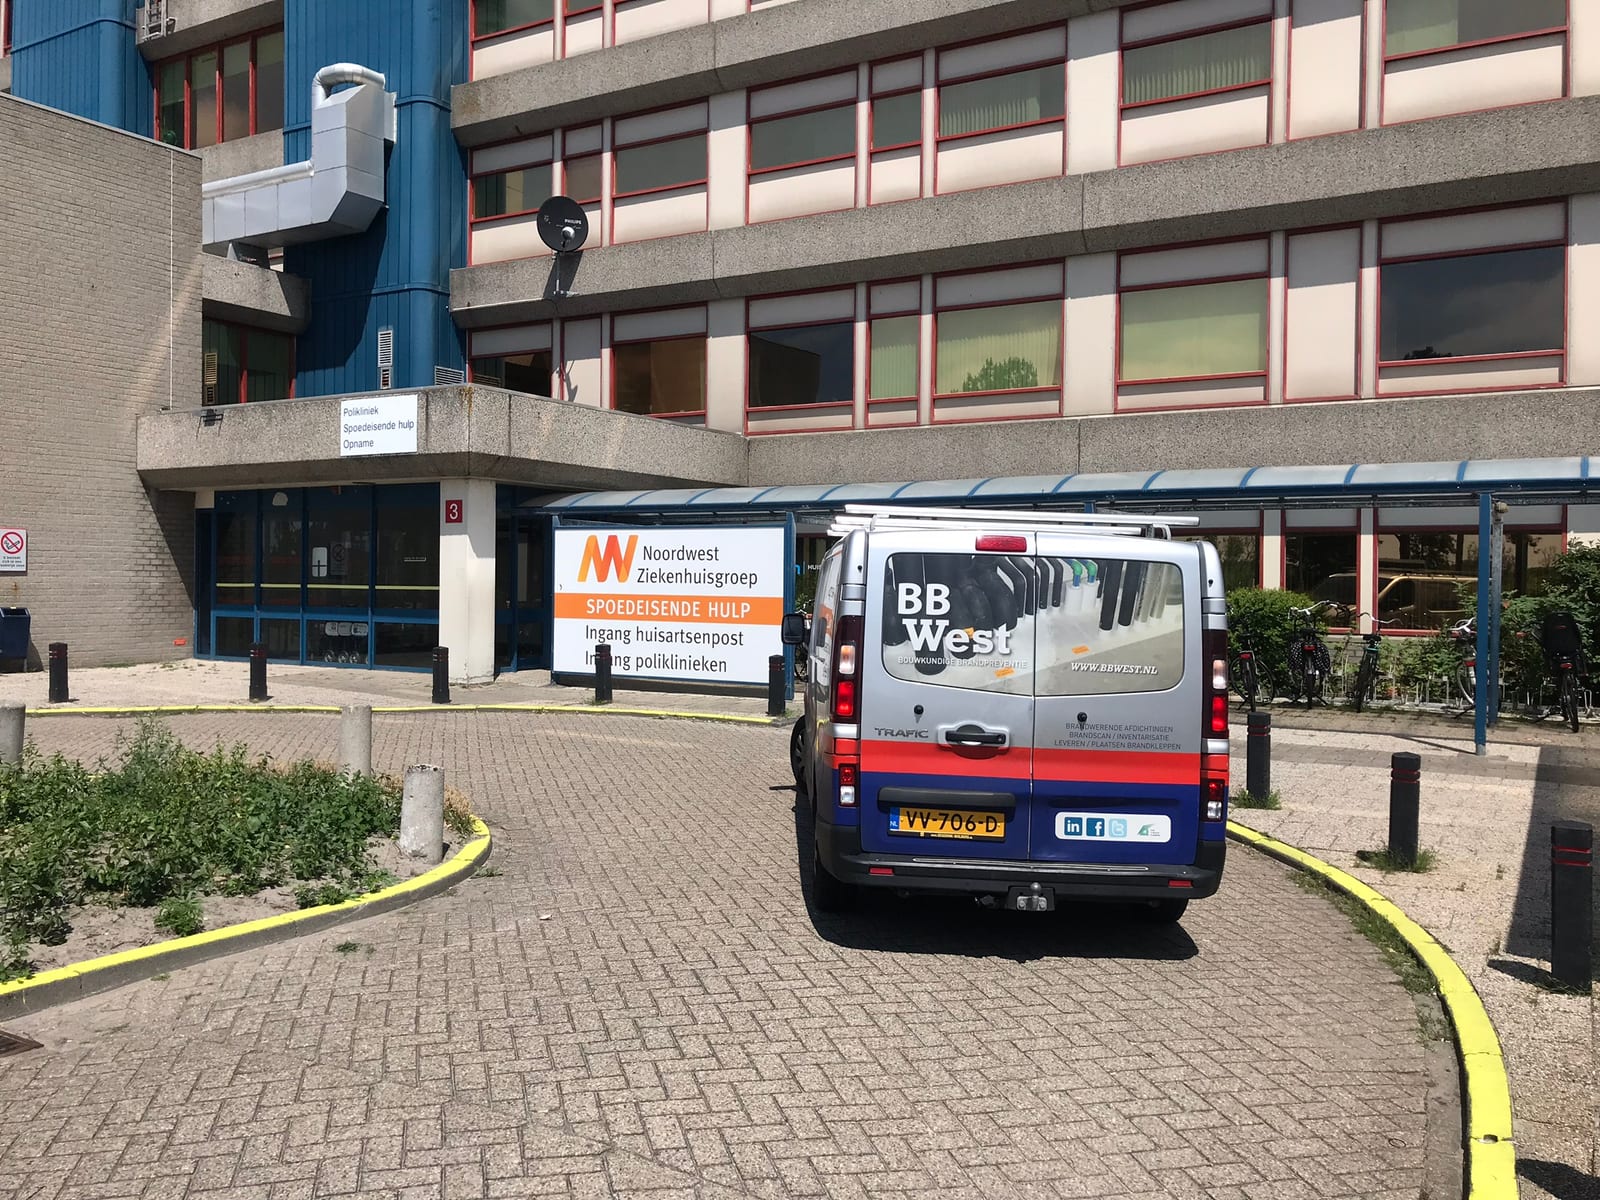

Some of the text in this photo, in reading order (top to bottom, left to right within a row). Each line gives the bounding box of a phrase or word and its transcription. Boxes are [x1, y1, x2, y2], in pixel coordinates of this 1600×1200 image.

[343, 406, 379, 417] Polikliniek
[343, 420, 415, 435] Spoedeisende hulp
[343, 440, 375, 451] Opname
[449, 503, 459, 520] 3
[643, 545, 720, 562] Noordwest
[637, 568, 758, 588] Ziekenhuisgroep
[897, 582, 951, 616] BB
[586, 598, 751, 619] SPOEDEISENDE HULP
[586, 624, 744, 649] Ingang huisartsenpost
[902, 618, 1012, 655] West
[585, 650, 728, 673] Inng poliklinieken
[898, 656, 1029, 669] BOUWKUNDIGE BRANDPREVENTIE
[1071, 662, 1158, 675] WWW.BBWEST.NL
[875, 727, 929, 739] TRAFIC
[1065, 723, 1174, 733] BRANDWERENDE AFDICHTINGEN
[1054, 739, 1085, 748] LEVEREN
[1091, 741, 1126, 749] PLAATSEN
[1127, 742, 1182, 750] BRANDKLEPPEN
[1069, 732, 1112, 740] BRANDSCAN
[1116, 733, 1170, 742] INVENTARISATIE
[890, 810, 998, 833] NL VV-706-D
